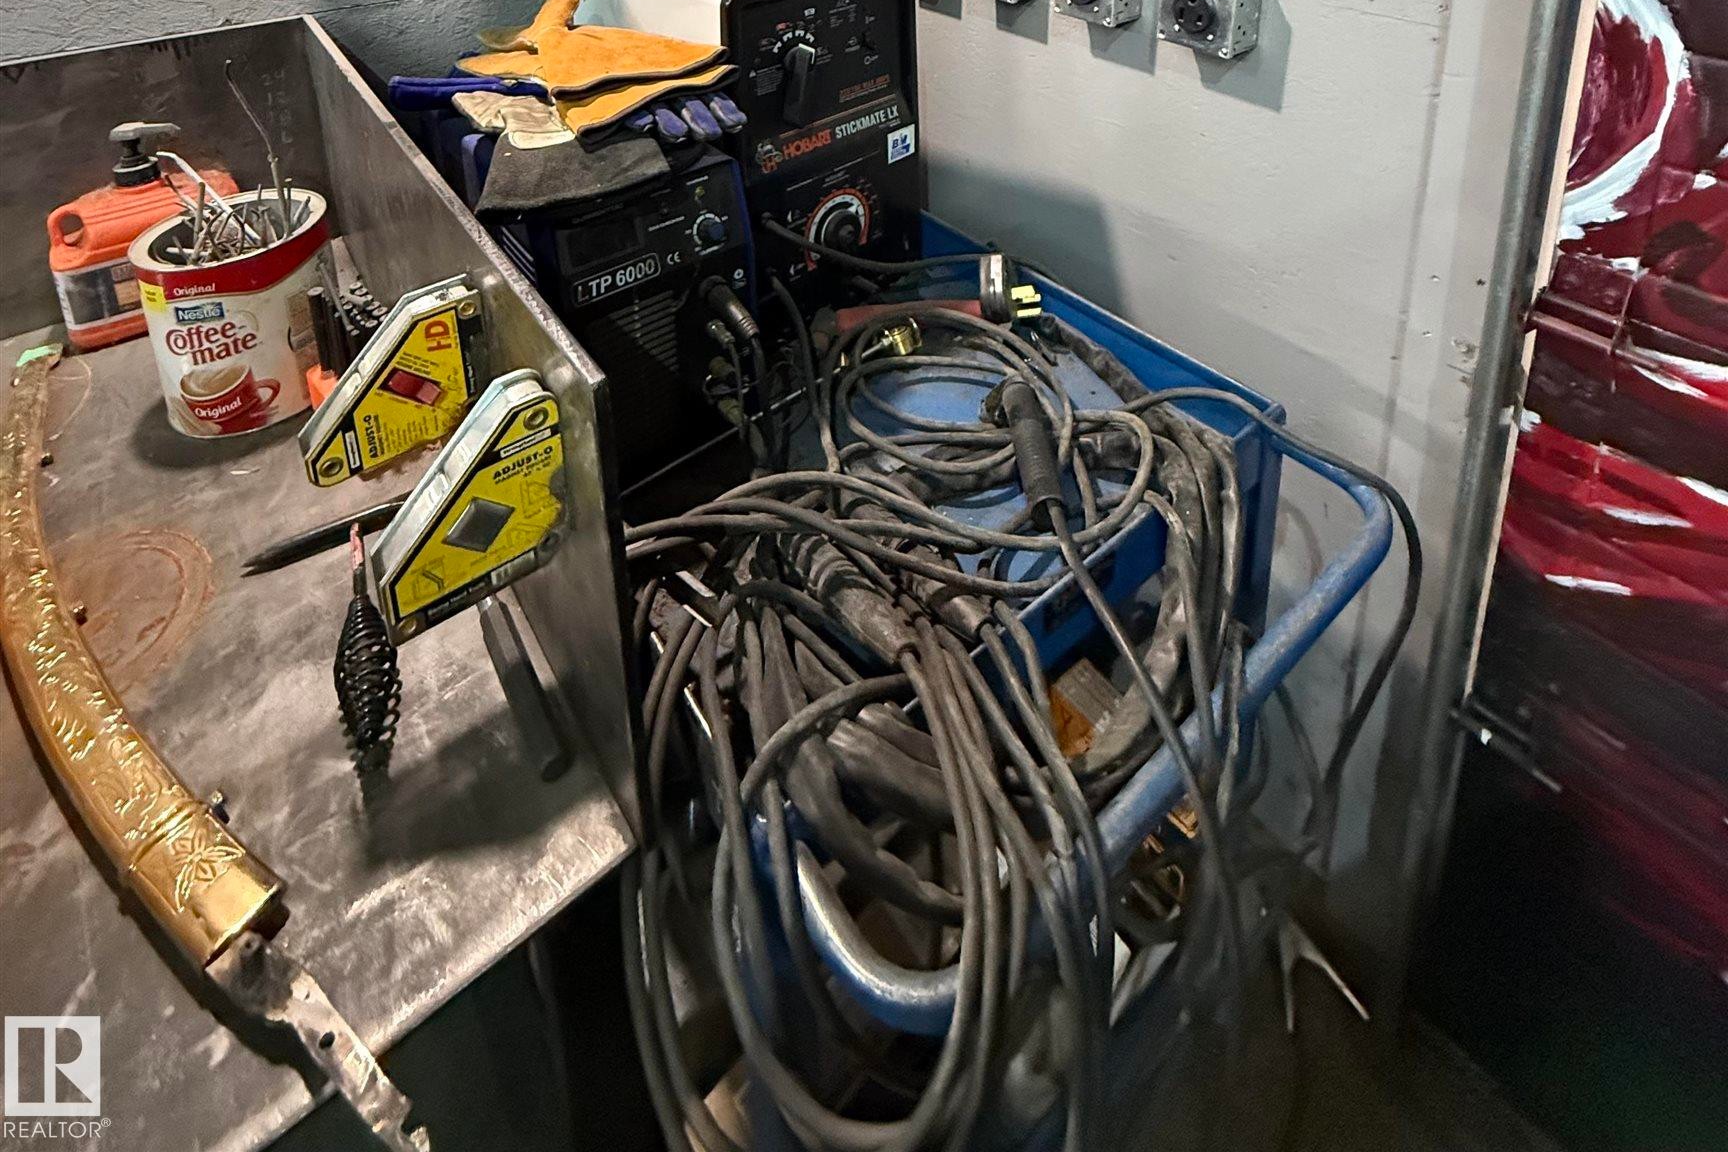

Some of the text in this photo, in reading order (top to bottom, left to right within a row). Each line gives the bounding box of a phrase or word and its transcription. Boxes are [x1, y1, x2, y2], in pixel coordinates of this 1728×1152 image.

[782, 105, 899, 160] HOBART STICKMATE LX
[173, 283, 216, 297] Original
[577, 258, 655, 302] LTP 6000
[187, 332, 258, 366] mate
[424, 320, 452, 352] HD
[194, 397, 242, 419] Original
